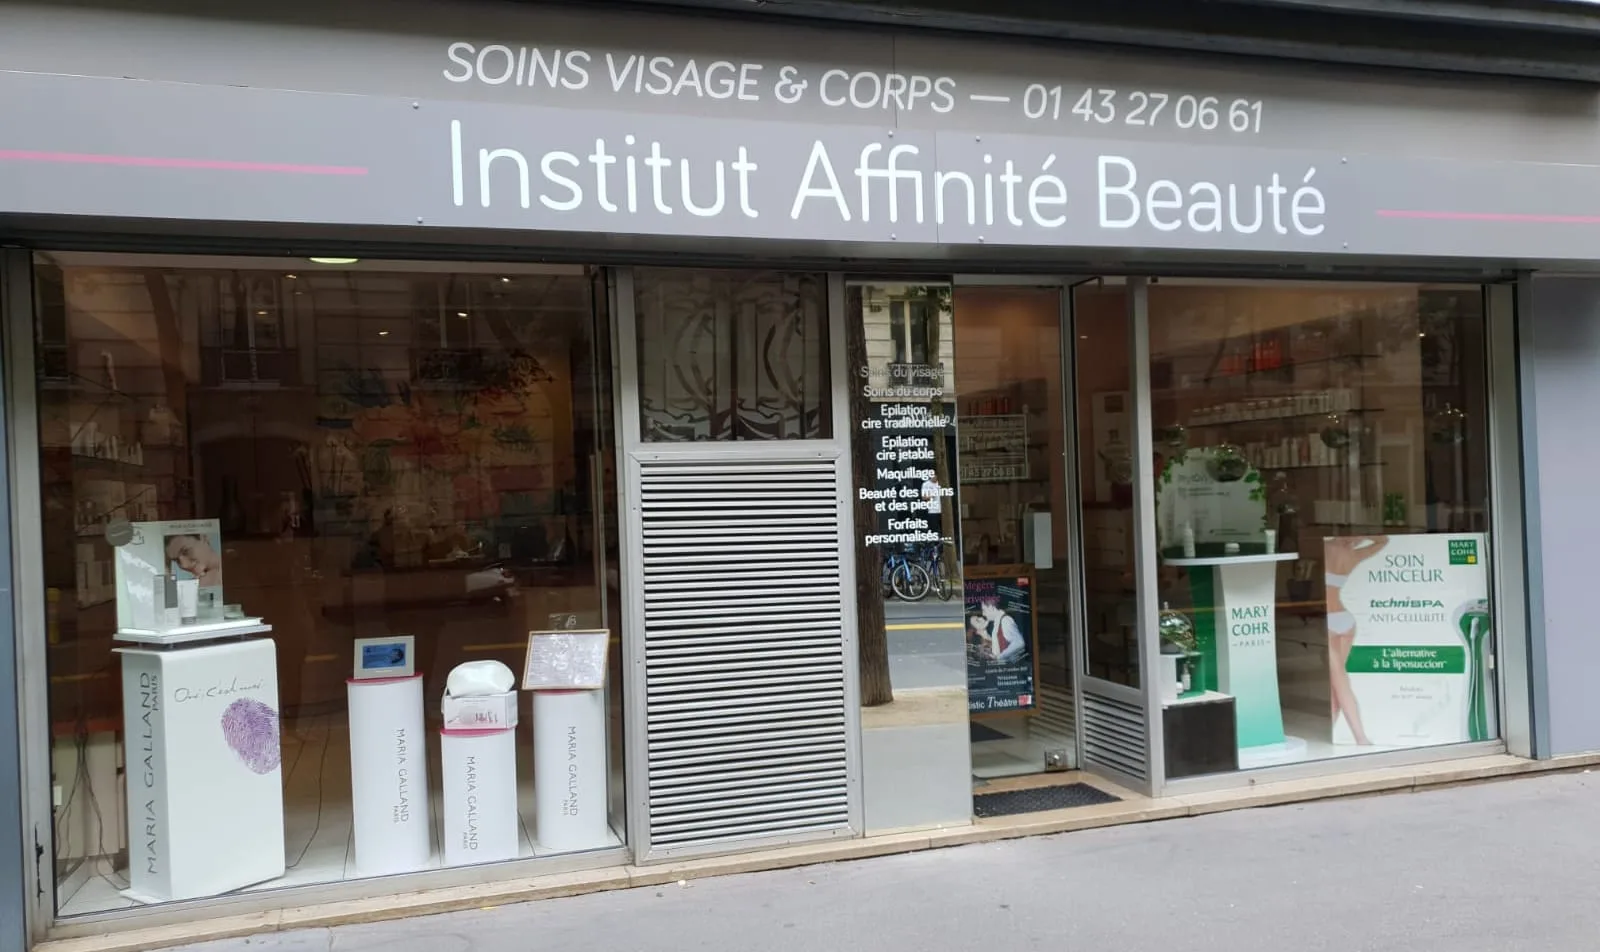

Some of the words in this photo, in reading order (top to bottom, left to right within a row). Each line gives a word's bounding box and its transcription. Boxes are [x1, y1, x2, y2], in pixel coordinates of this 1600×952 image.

[443, 41, 592, 91] SOINS
[606, 53, 763, 101] VISAGE
[774, 65, 807, 104] &
[820, 69, 956, 113] CORPS
[1023, 83, 1062, 120] 01
[1072, 89, 1117, 124] 43
[1125, 91, 1169, 127] 27
[1175, 95, 1219, 131] 06
[1229, 98, 1264, 134] 61
[450, 119, 759, 218] Institut
[790, 140, 1068, 228] Affinité
[1097, 154, 1326, 236] Beauté
[894, 365, 908, 378] du
[911, 366, 944, 380] visage
[863, 385, 894, 397] Soins
[896, 385, 911, 396] du
[912, 387, 943, 399] corps
[880, 404, 927, 417] Epilation
[861, 417, 882, 429] cire
[881, 436, 928, 449] Epilation
[876, 450, 897, 461] cire
[898, 448, 934, 463] jetable
[876, 466, 936, 482] Maquillage
[859, 487, 897, 500] Beauté
[899, 486, 919, 498] des
[921, 485, 954, 497] mains
[874, 500, 886, 512] et
[888, 499, 908, 511] des
[910, 498, 939, 513] pieds
[887, 518, 928, 531] Forfaits
[1384, 554, 1425, 568] SOIN
[1368, 568, 1444, 584] MINCEUR
[1231, 604, 1269, 620] MARY
[1231, 621, 1271, 637] COHR
[1382, 648, 1437, 658] L'alternative
[1382, 659, 1390, 669] la
[151, 674, 160, 712] PARIS
[139, 672, 154, 788] GALLAND
[396, 728, 407, 765] MARIA
[568, 726, 577, 761] MARIA
[467, 756, 476, 792] MARIA
[398, 768, 409, 822] GALLAND
[568, 764, 578, 816] GALLAND
[468, 796, 478, 850] GALLAND
[145, 799, 158, 874] MARIA
